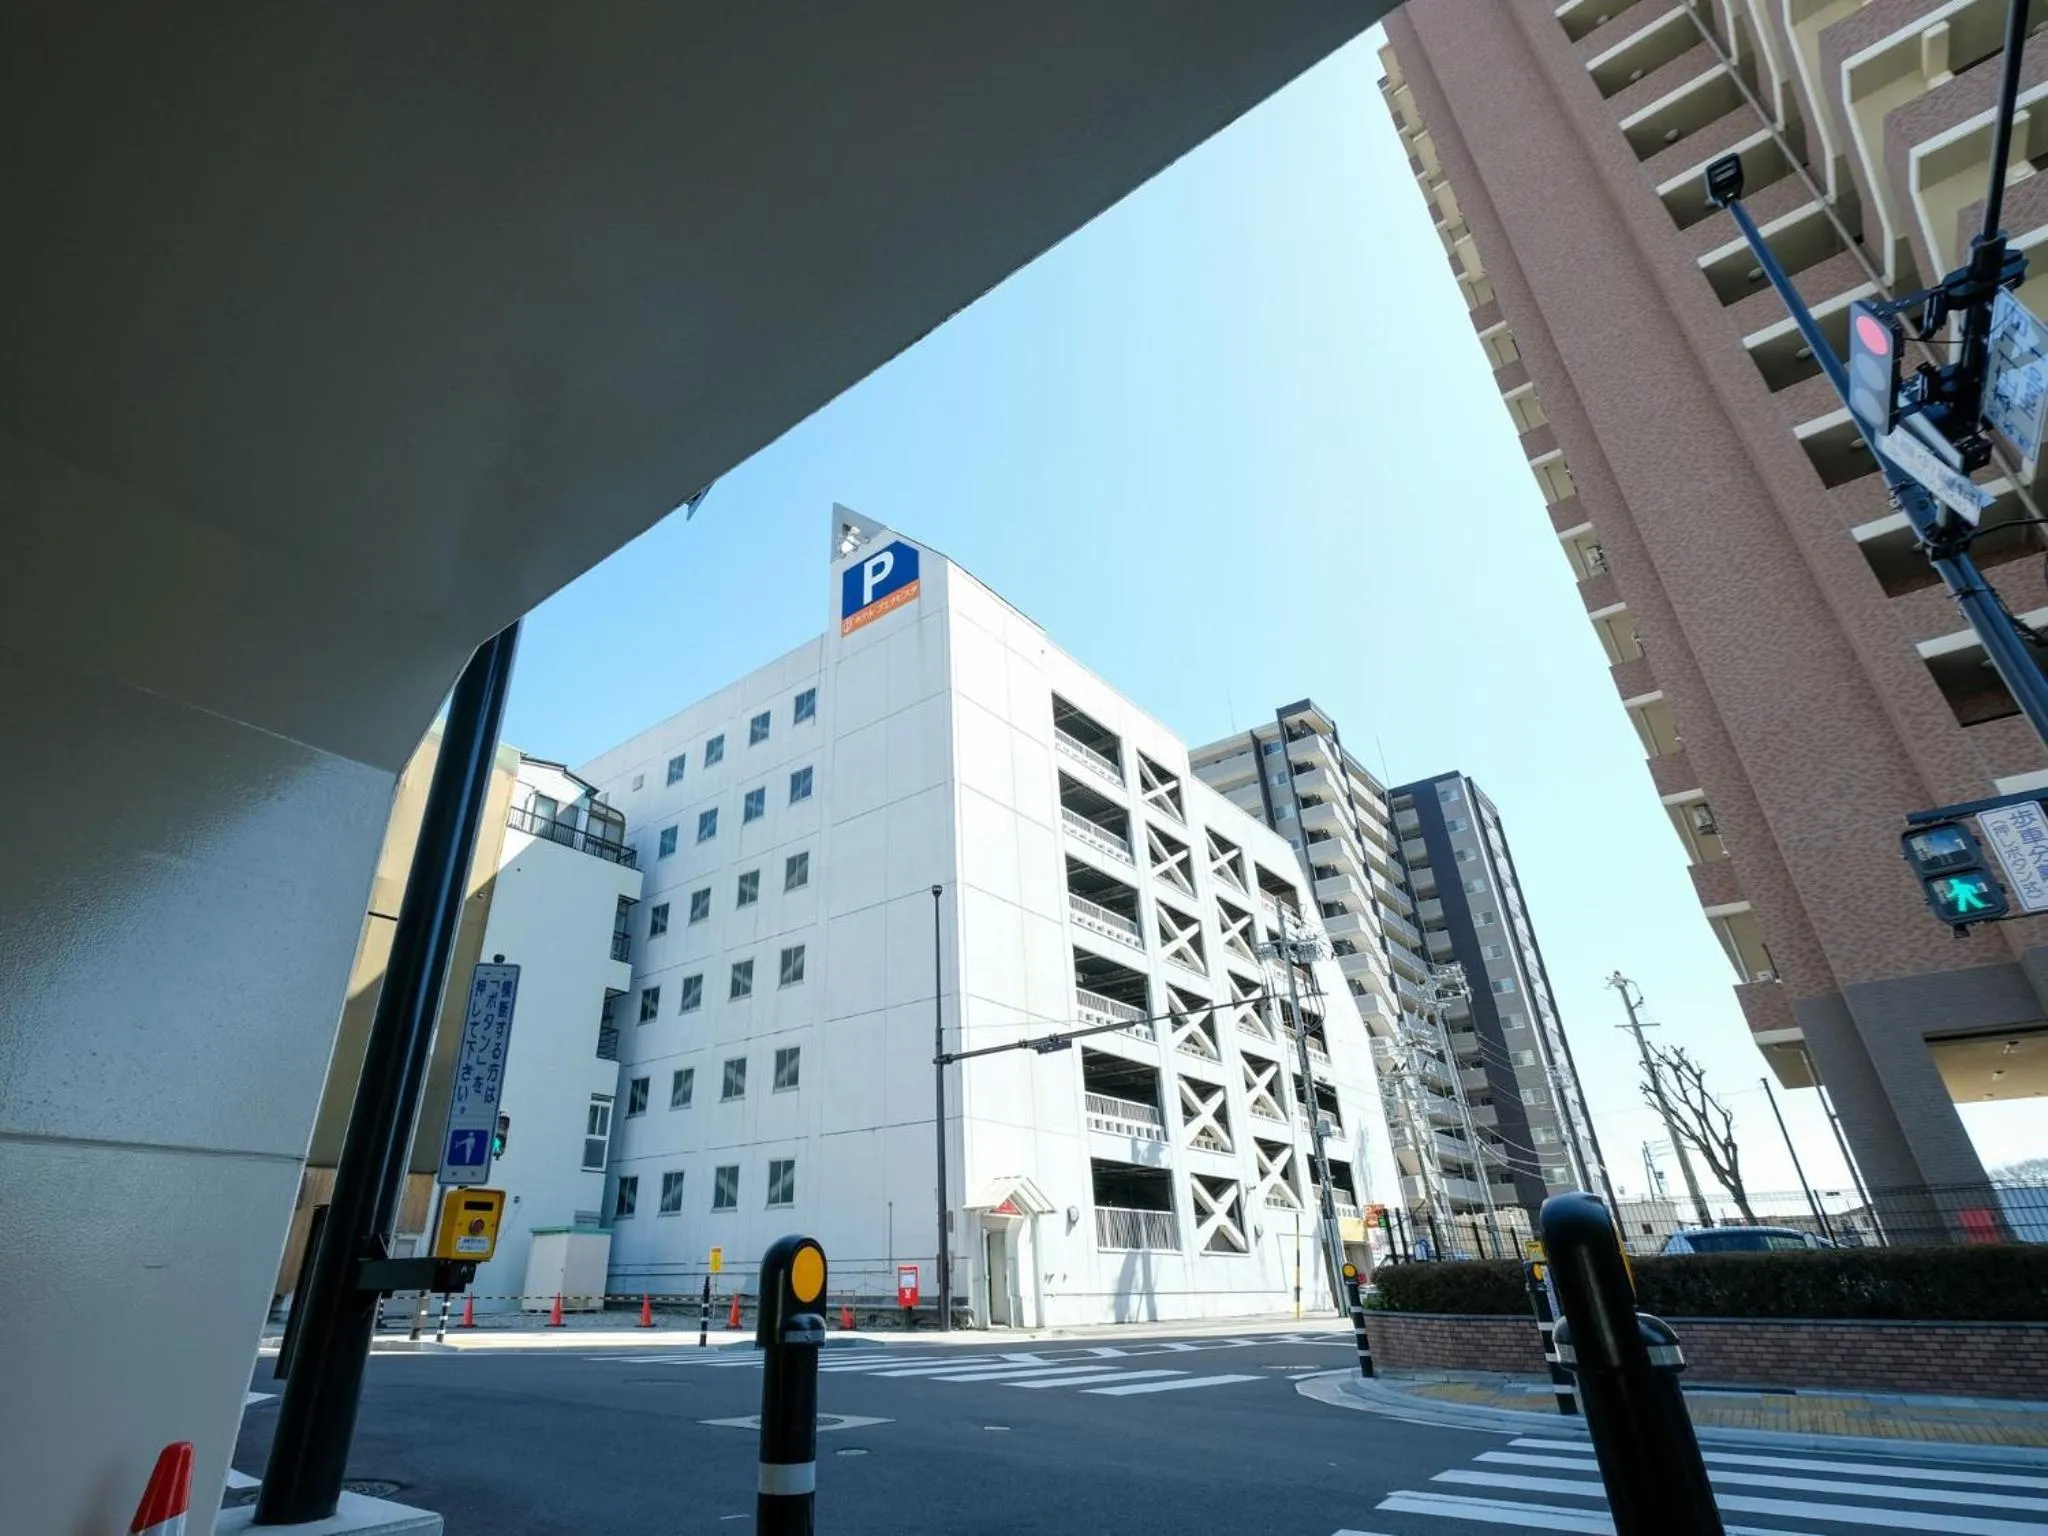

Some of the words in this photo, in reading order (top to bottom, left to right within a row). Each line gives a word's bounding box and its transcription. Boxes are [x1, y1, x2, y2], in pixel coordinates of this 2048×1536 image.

[863, 551, 894, 605] P
[483, 980, 513, 1104] 横断する方は
